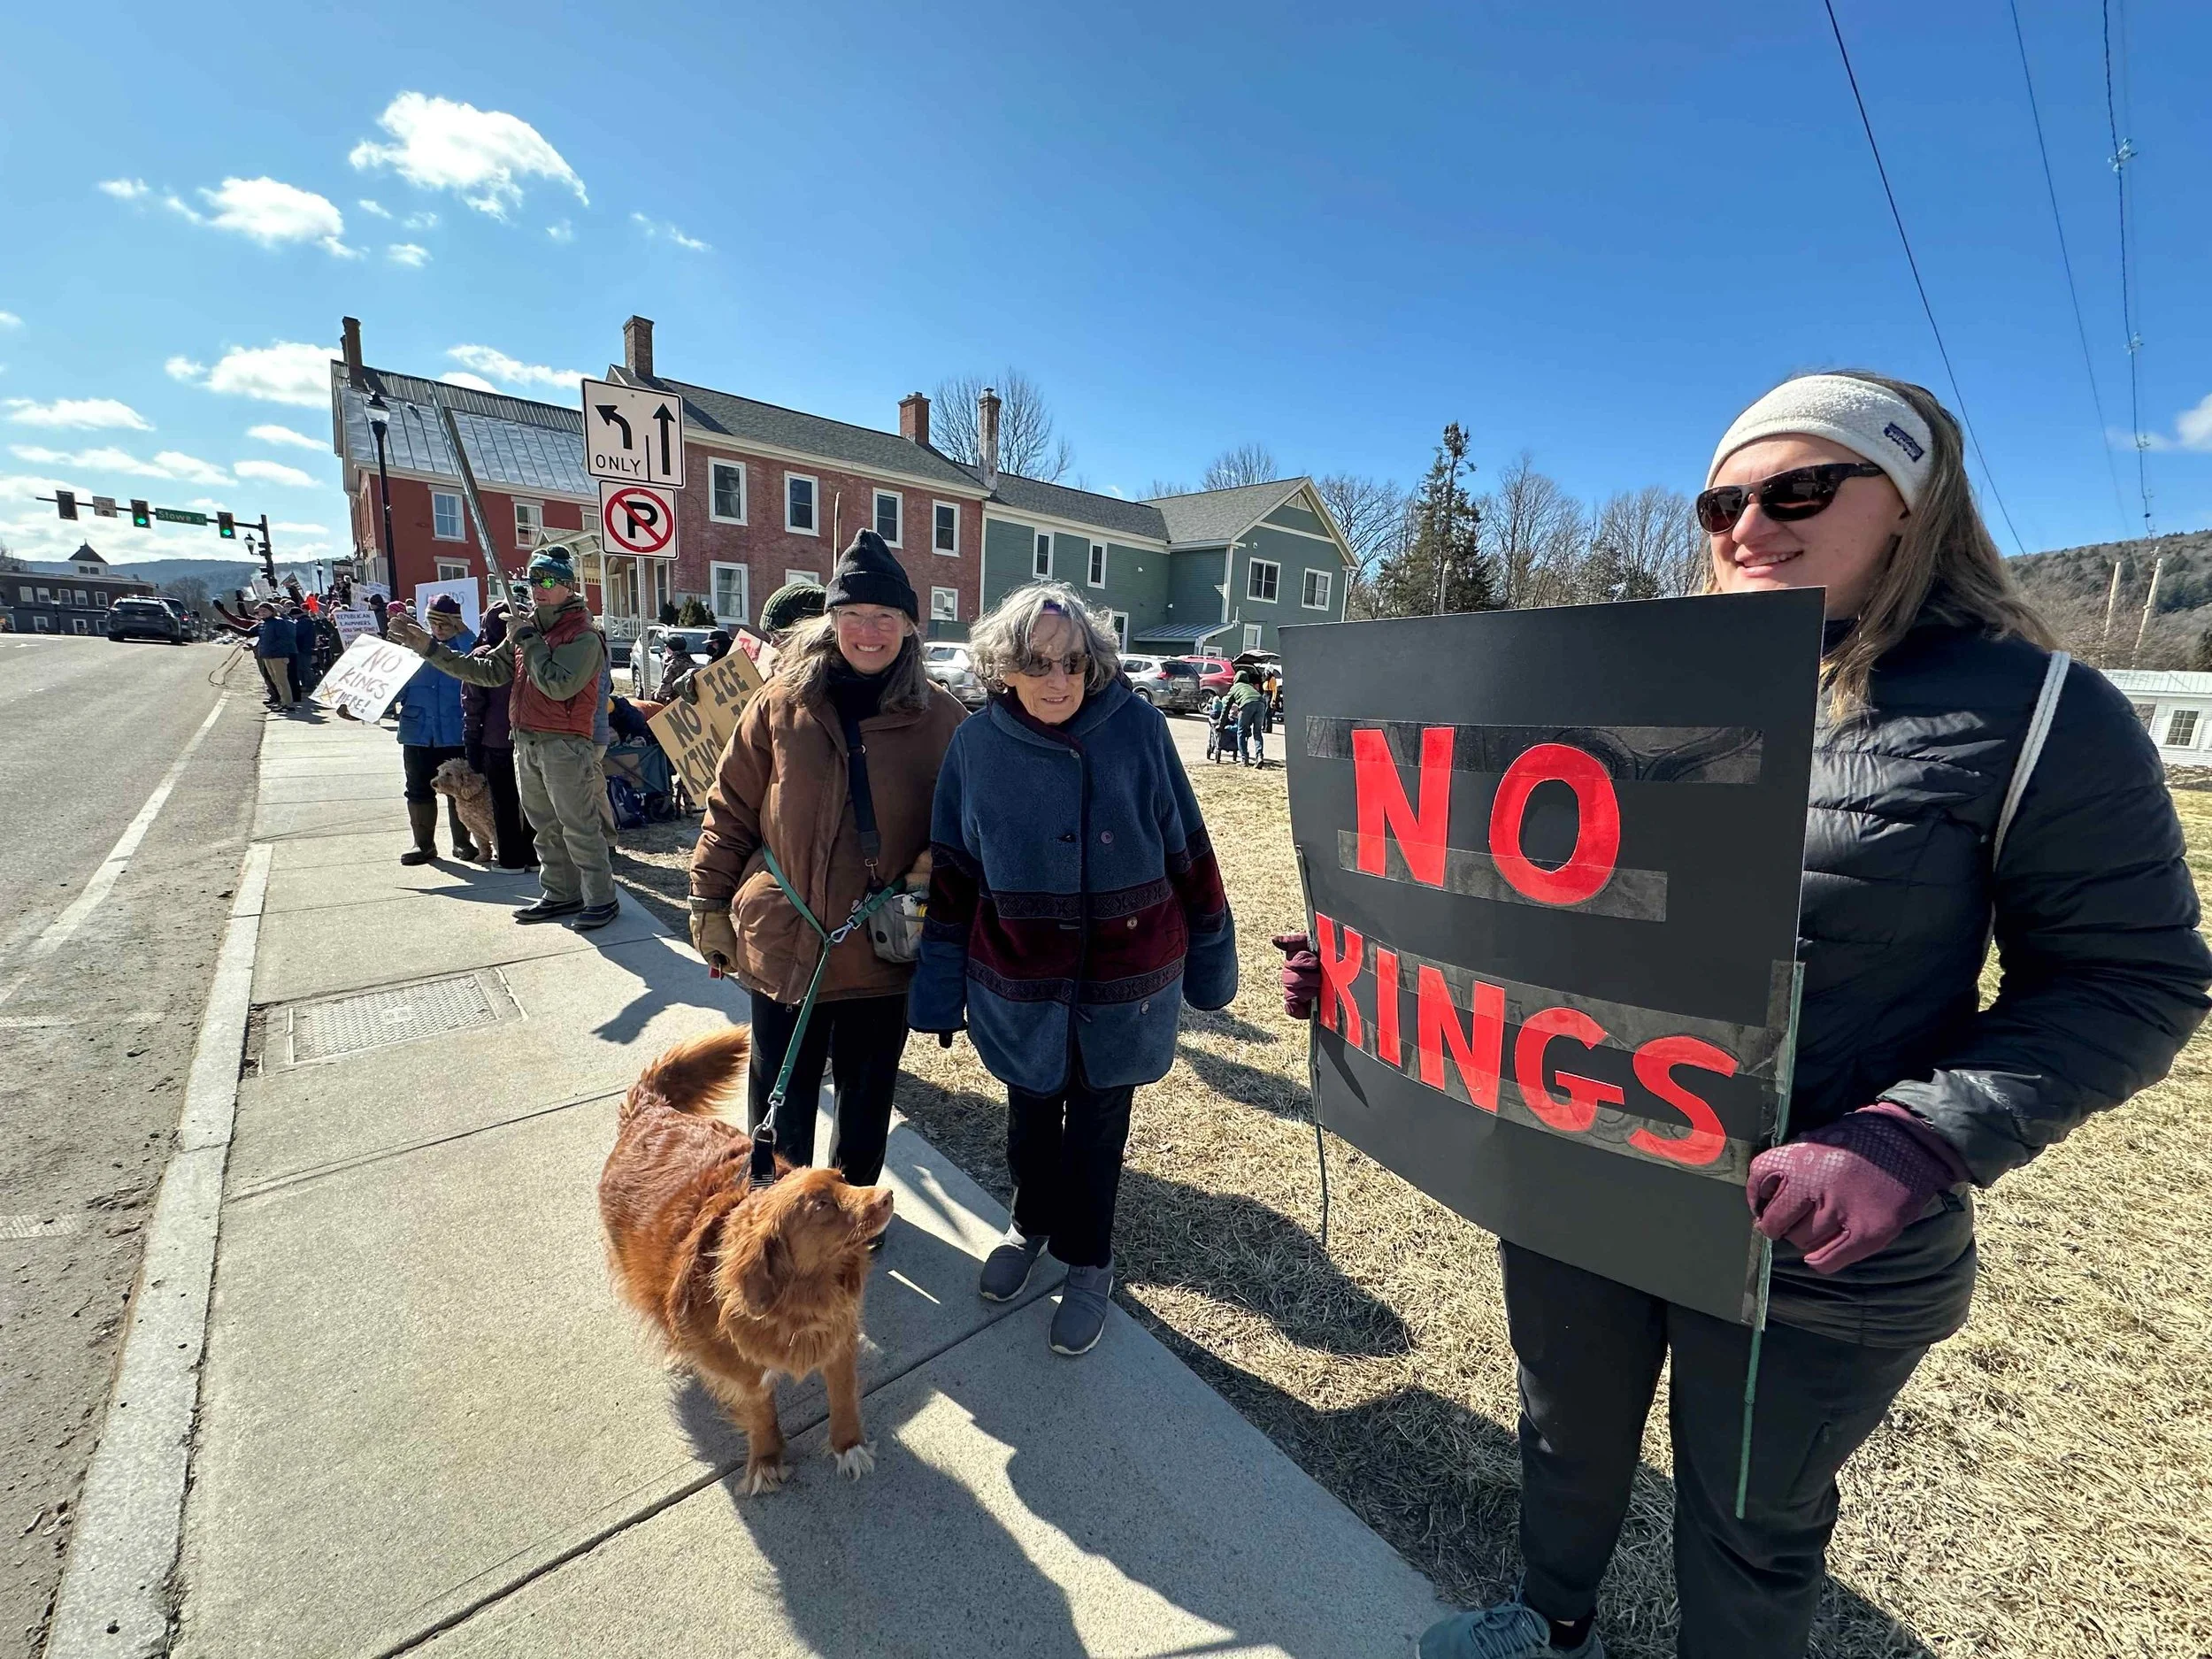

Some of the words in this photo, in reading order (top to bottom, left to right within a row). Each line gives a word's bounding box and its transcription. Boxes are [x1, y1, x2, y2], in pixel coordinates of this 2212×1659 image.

[595, 454, 641, 473] ONLY
[158, 511, 191, 523] Stowe
[626, 500, 658, 539] P
[361, 645, 403, 673] NO
[338, 666, 389, 700] KINGS
[703, 659, 749, 707] ICE
[335, 691, 371, 714] HERE!
[664, 700, 703, 749] NO
[1351, 726, 1620, 907] NO
[1314, 911, 1737, 1168] KINGS
